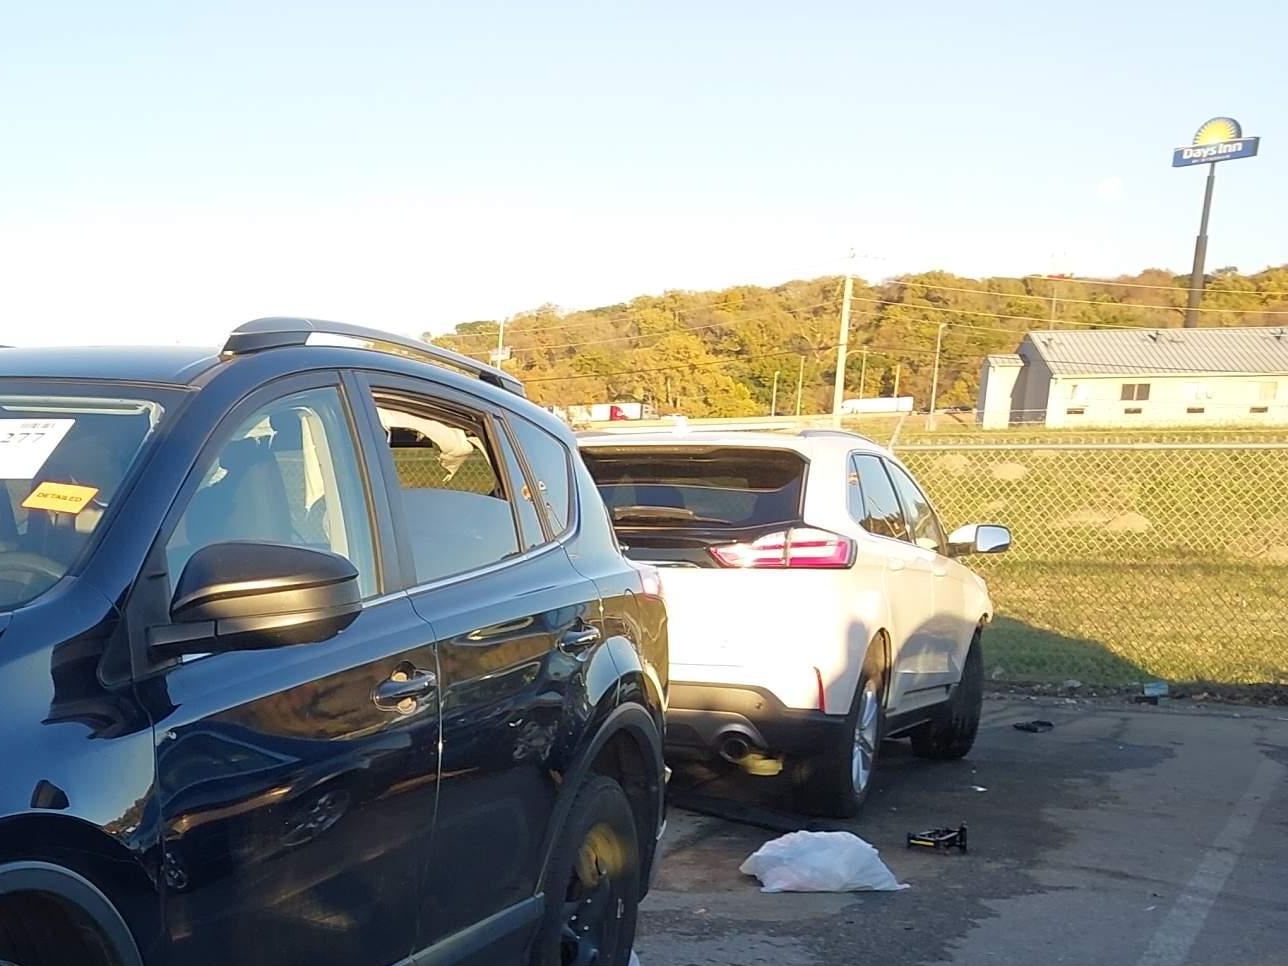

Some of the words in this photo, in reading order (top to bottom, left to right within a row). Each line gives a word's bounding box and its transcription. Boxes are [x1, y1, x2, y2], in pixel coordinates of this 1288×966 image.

[1182, 146, 1217, 160] Days
[1218, 142, 1243, 154] Inn
[36, 492, 83, 503] DETAILED
